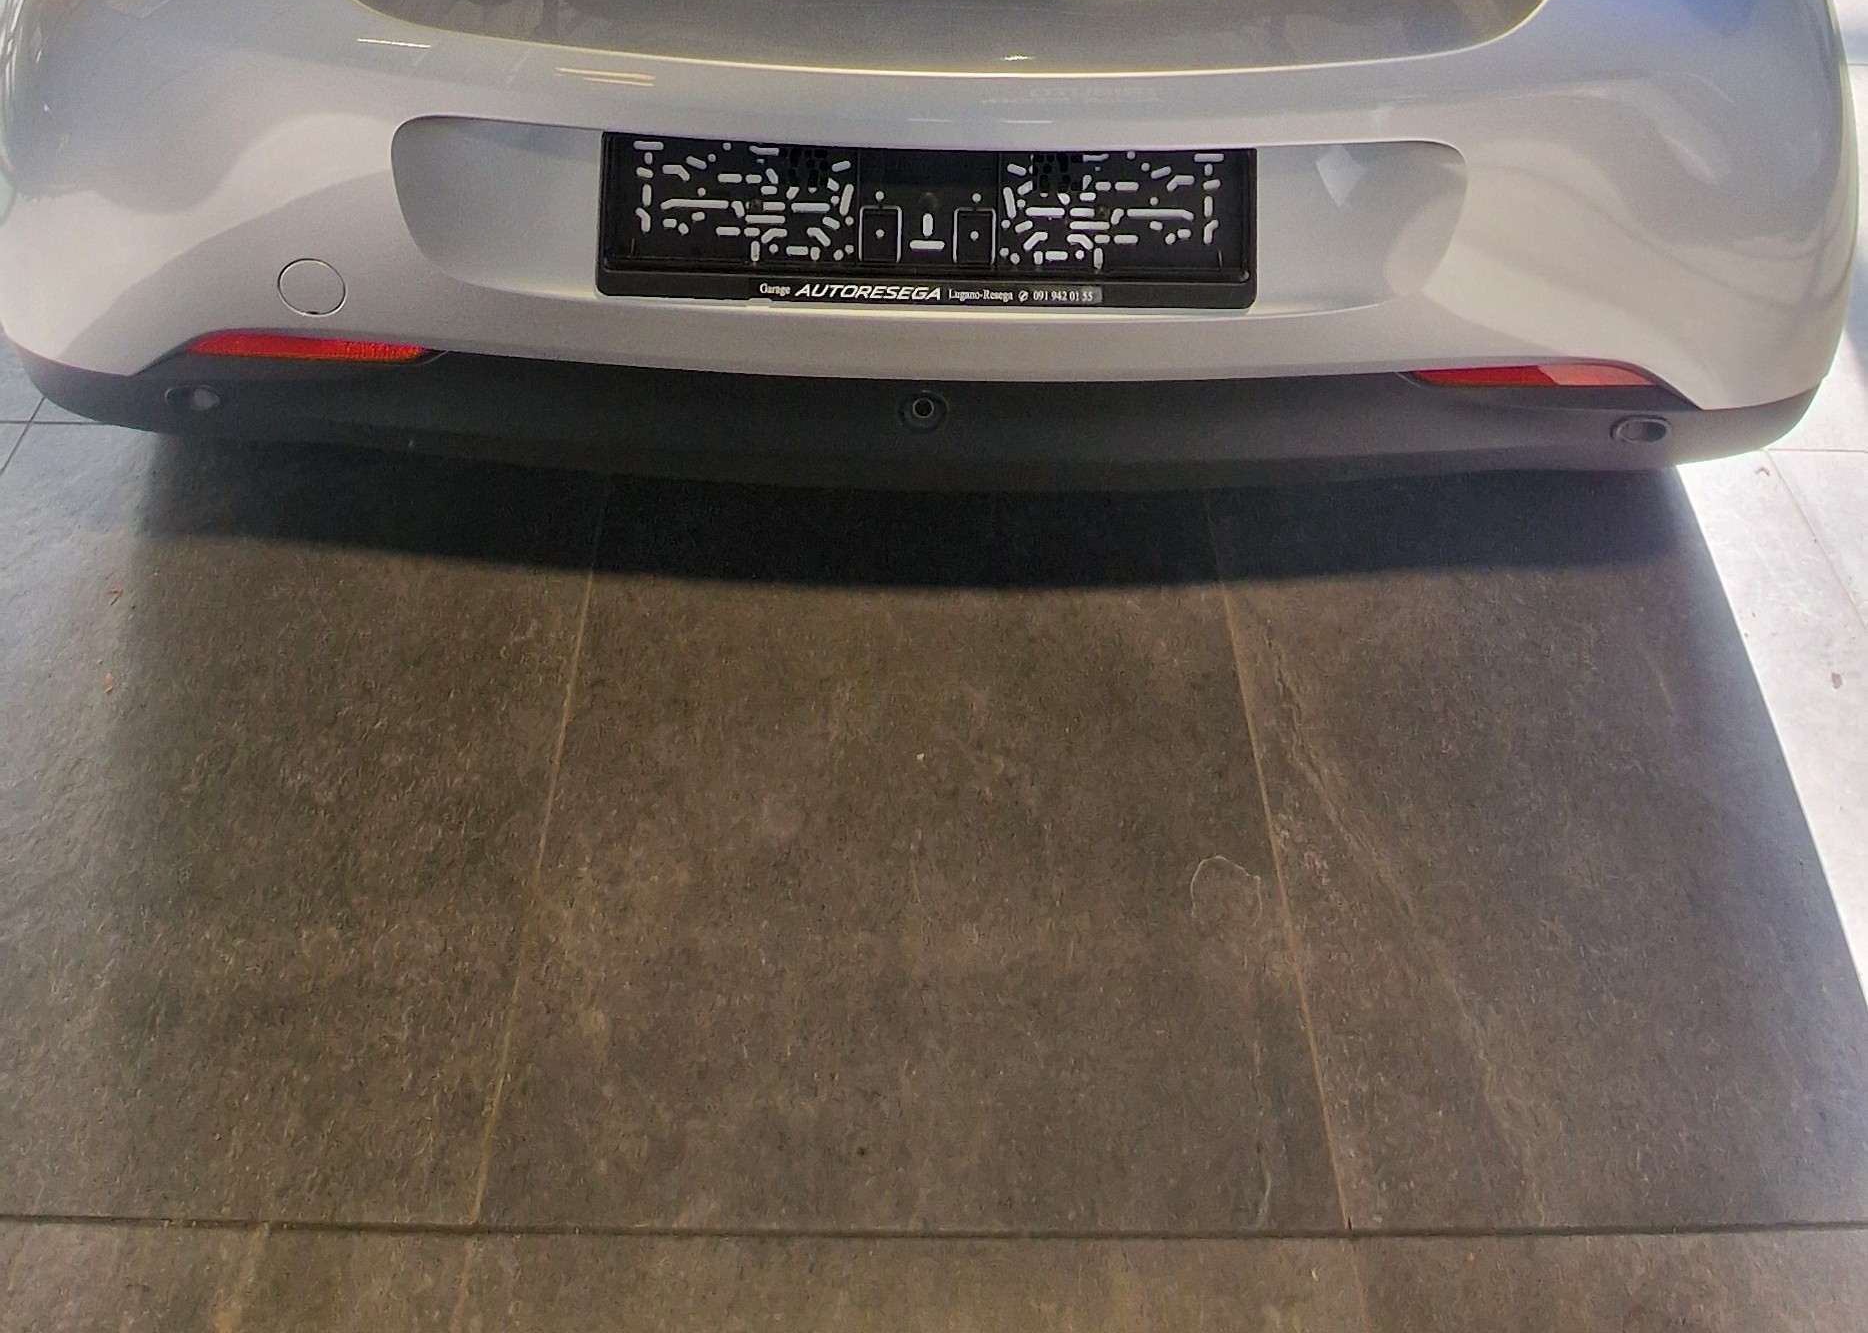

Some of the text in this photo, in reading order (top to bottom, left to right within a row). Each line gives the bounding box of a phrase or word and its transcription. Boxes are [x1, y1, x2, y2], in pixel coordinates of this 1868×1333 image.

[759, 282, 791, 297] Garage
[794, 283, 942, 301] AUTORESEGA
[948, 288, 1013, 303] Lugano-Resega
[1033, 290, 1048, 301] 091
[1069, 291, 1080, 302] 01
